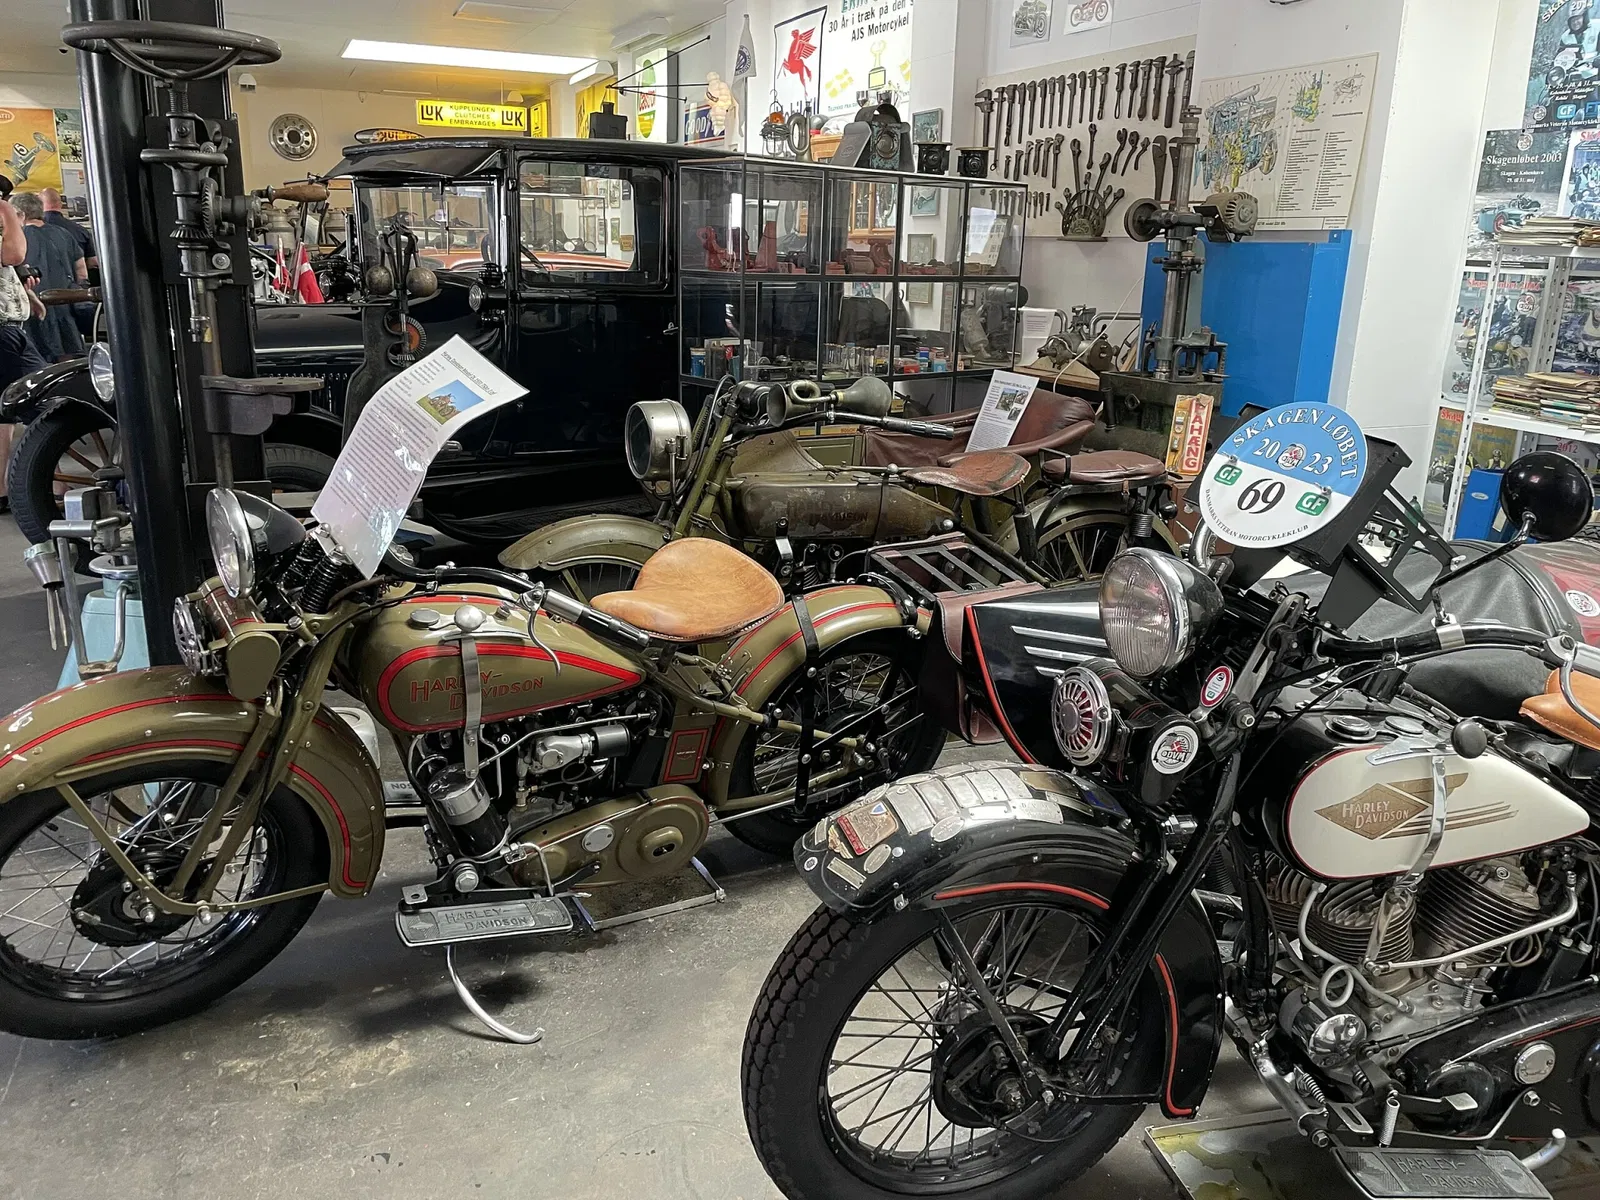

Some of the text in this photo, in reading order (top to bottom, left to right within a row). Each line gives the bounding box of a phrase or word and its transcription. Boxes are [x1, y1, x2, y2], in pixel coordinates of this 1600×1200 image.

[829, 20, 838, 33] 30
[857, 7, 875, 24] træk
[851, 12, 910, 41] AJS Motorcykel
[449, 104, 496, 113] KUPPLUNGEN
[454, 112, 491, 120] CLUTCHES
[449, 118, 497, 127] EMBRAYAGES
[1485, 152, 1562, 167] Skagenløbet 2003
[1233, 408, 1324, 448] SKAGEN
[1321, 413, 1360, 479] LØBET
[1219, 466, 1238, 481] GF
[1237, 478, 1286, 514] 69
[1301, 493, 1325, 511] GF
[1205, 488, 1309, 542] DANMARKS VETERAN MOTORCYKLEKLUB
[410, 670, 502, 703] HARY-
[449, 676, 544, 711] DVIDSON
[1342, 800, 1390, 819] HARLEY
[1355, 808, 1410, 829] DAVIDSON
[464, 916, 529, 932] DAVIDSON
[1423, 1173, 1500, 1189] DAVIDSON
